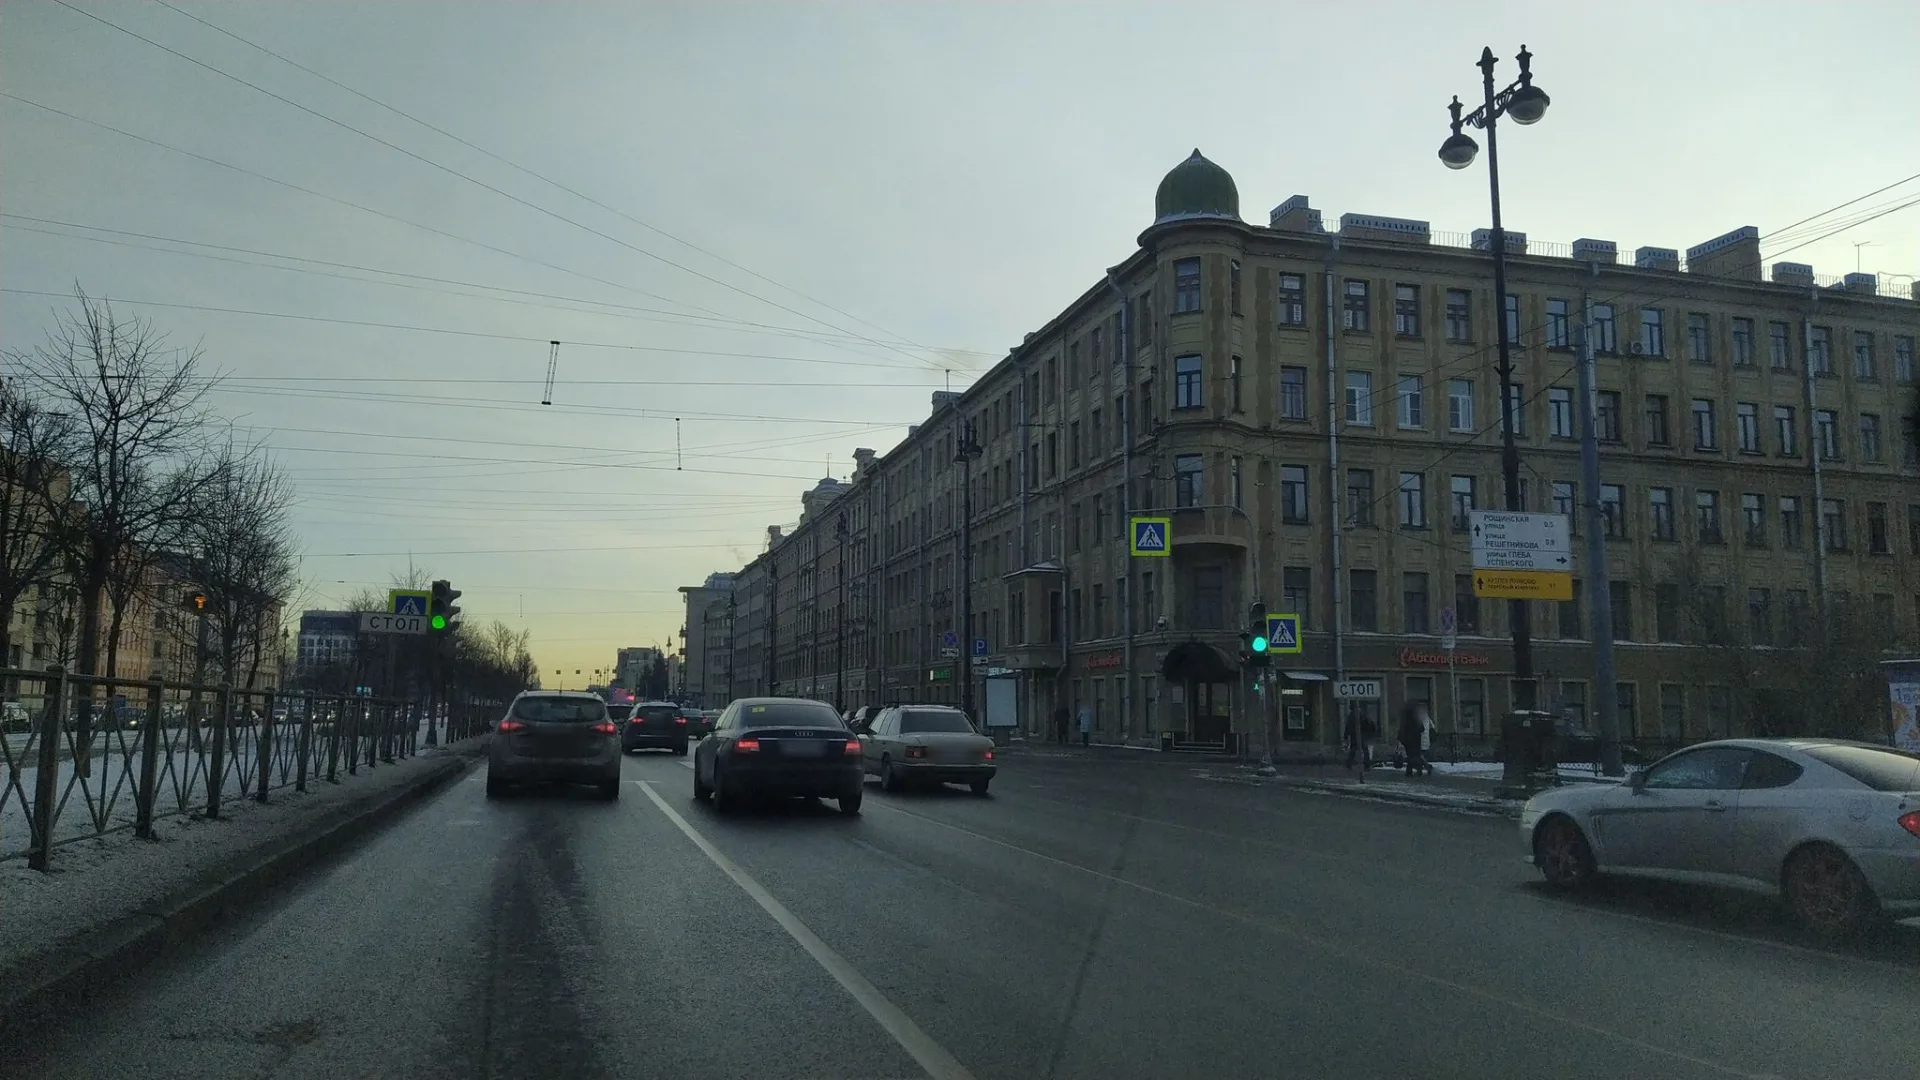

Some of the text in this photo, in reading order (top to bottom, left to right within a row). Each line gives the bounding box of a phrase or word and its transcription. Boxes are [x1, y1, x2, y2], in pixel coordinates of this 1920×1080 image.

[1483, 514, 1530, 523] РОЩИНСКАЯ
[1485, 540, 1540, 549] РЕШЕТНИКОВА
[1508, 551, 1532, 559] ГЛЕБА
[1486, 559, 1534, 568] УСПЕНСКОГО
[369, 616, 420, 632] СТОП
[1339, 683, 1375, 696] СТОП
